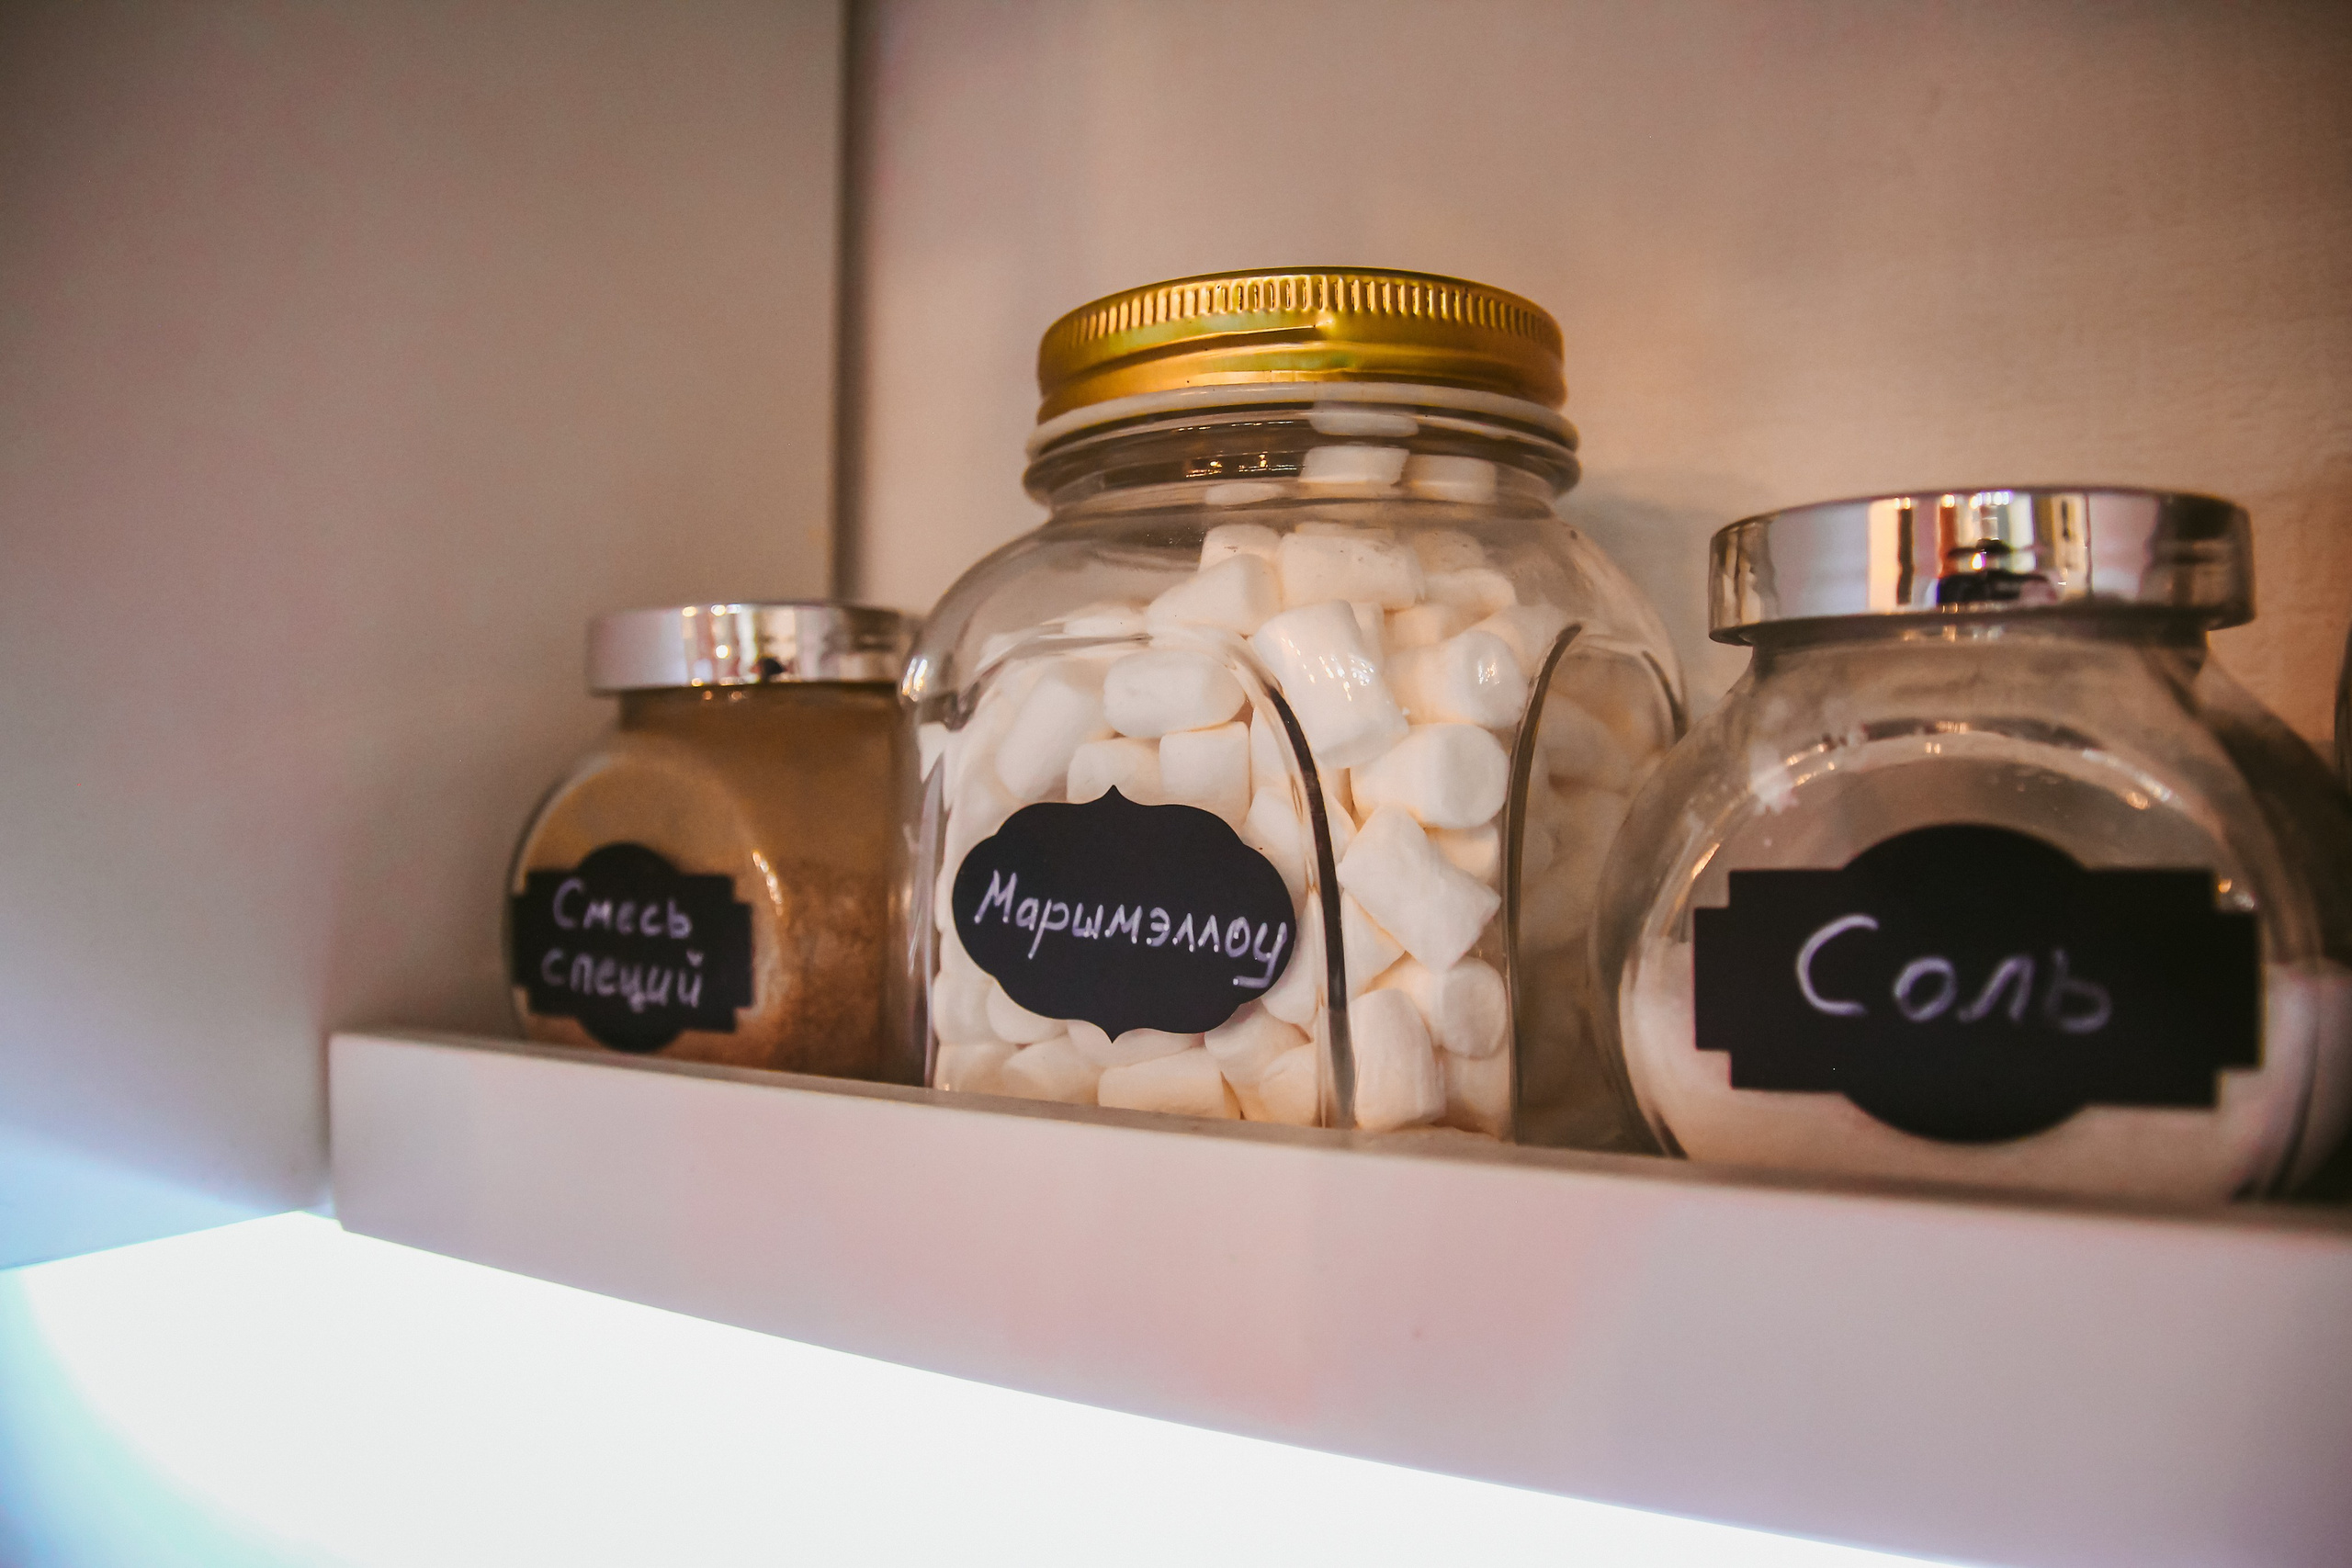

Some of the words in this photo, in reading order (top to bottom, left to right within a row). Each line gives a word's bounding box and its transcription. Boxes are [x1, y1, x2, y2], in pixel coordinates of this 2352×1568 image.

[552, 877, 693, 940] Смесь
[974, 869, 1287, 989] Маршмэллоу
[1795, 913, 2111, 1034] Соль
